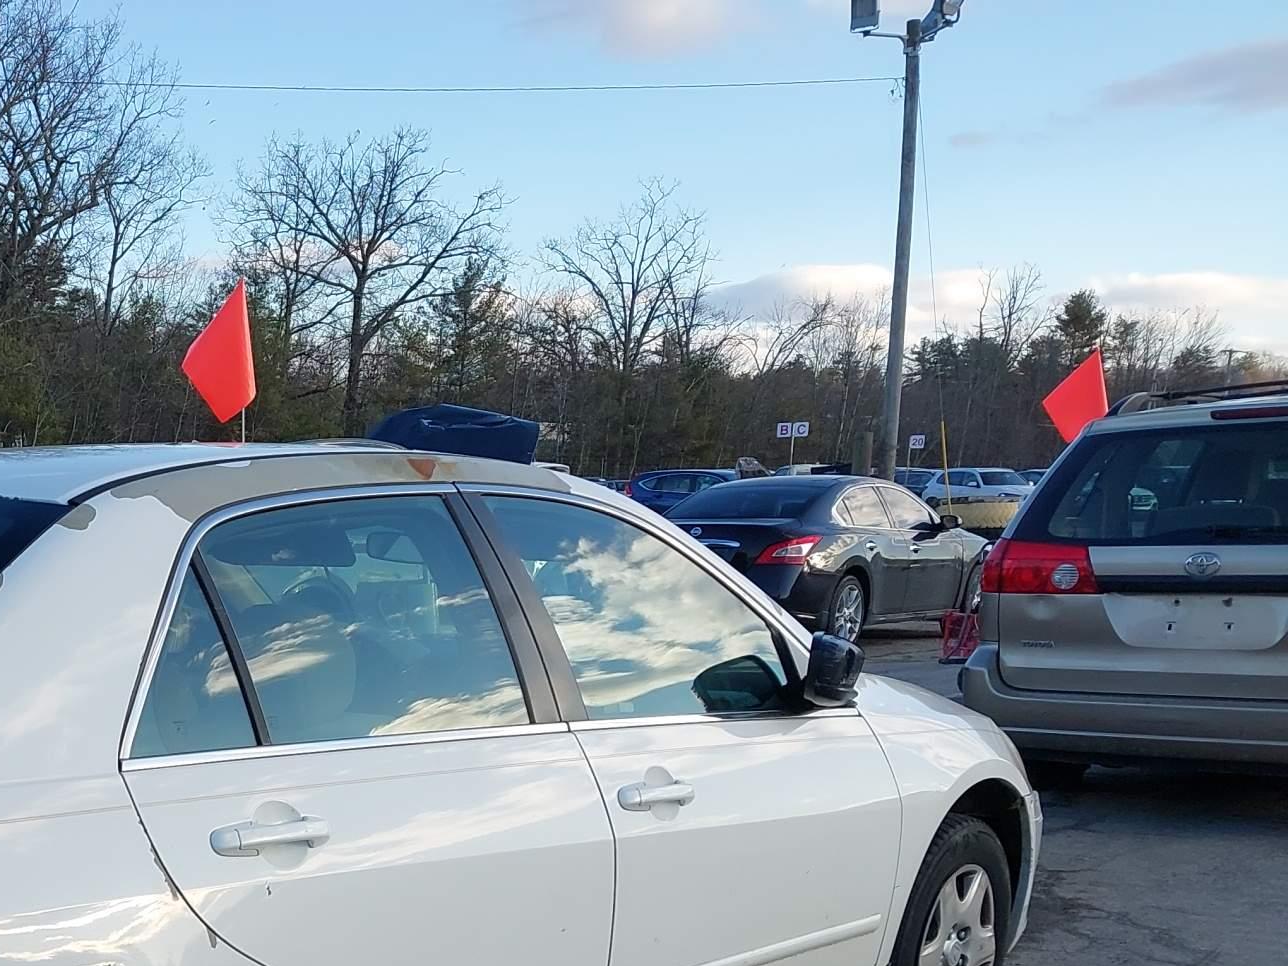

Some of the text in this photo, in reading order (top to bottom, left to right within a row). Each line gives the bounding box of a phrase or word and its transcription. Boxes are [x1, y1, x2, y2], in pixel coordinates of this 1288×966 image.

[780, 424, 789, 436] B
[797, 423, 806, 435] C
[912, 437, 924, 446] 20
